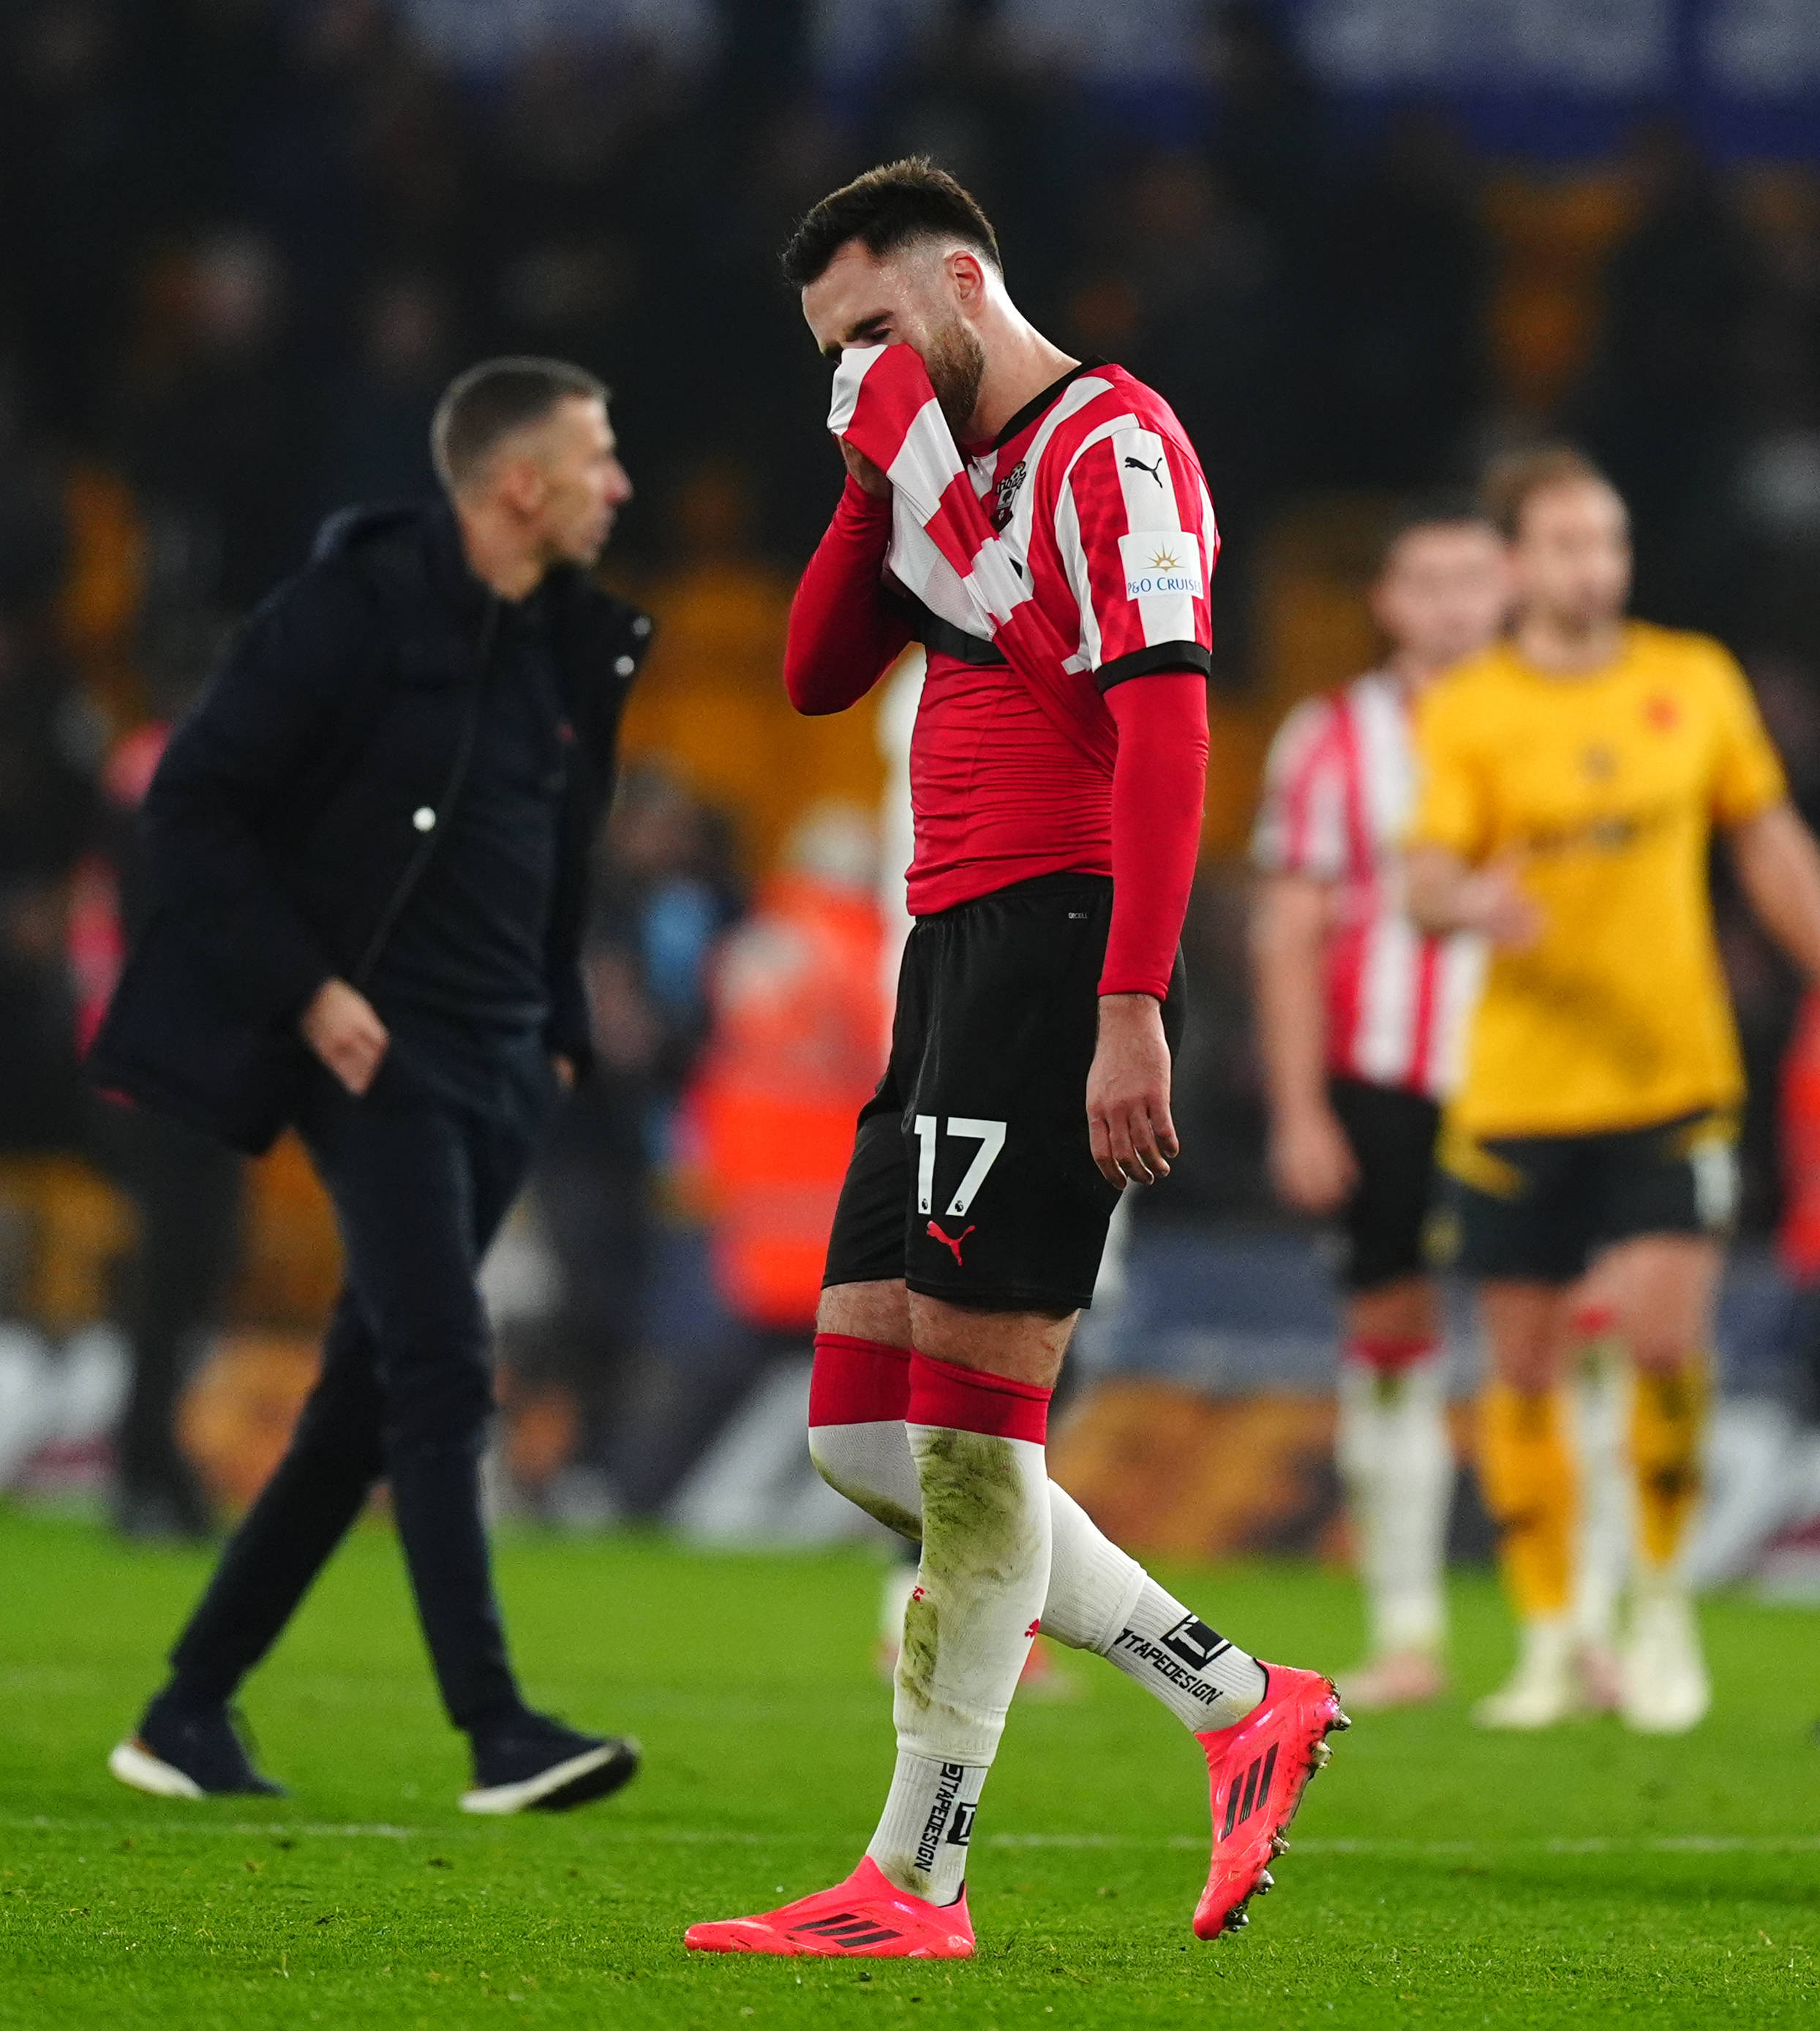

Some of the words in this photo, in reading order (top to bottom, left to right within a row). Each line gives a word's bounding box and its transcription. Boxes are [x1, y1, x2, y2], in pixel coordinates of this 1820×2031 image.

[914, 1114, 1007, 1217] 17
[1124, 1634, 1224, 1705] TAPEDESIGN
[914, 1781, 959, 1873] TAPEDESIGN
